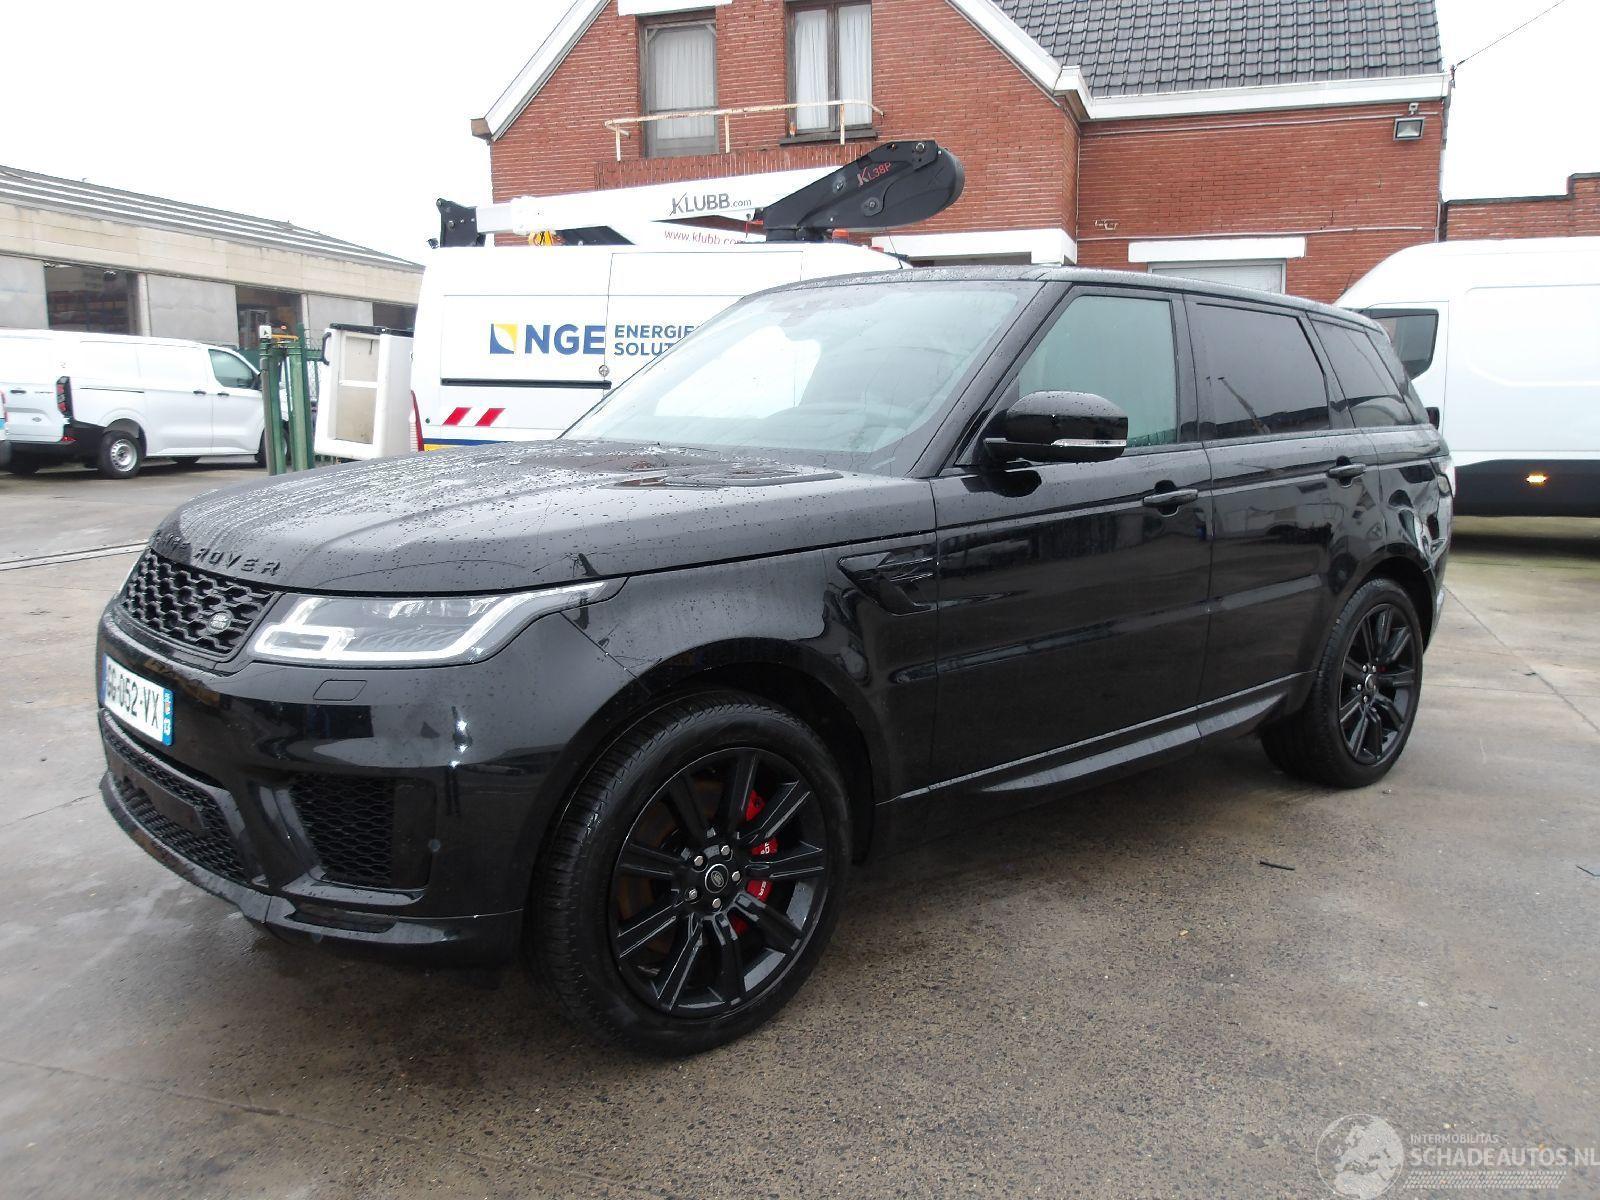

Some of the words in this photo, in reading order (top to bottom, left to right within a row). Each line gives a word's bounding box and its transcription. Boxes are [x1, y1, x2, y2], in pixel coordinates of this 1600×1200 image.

[669, 192, 752, 216] KLUBB.com
[664, 229, 747, 245] www.klubb.co
[525, 323, 606, 355] NGE
[193, 547, 281, 577] ROVER
